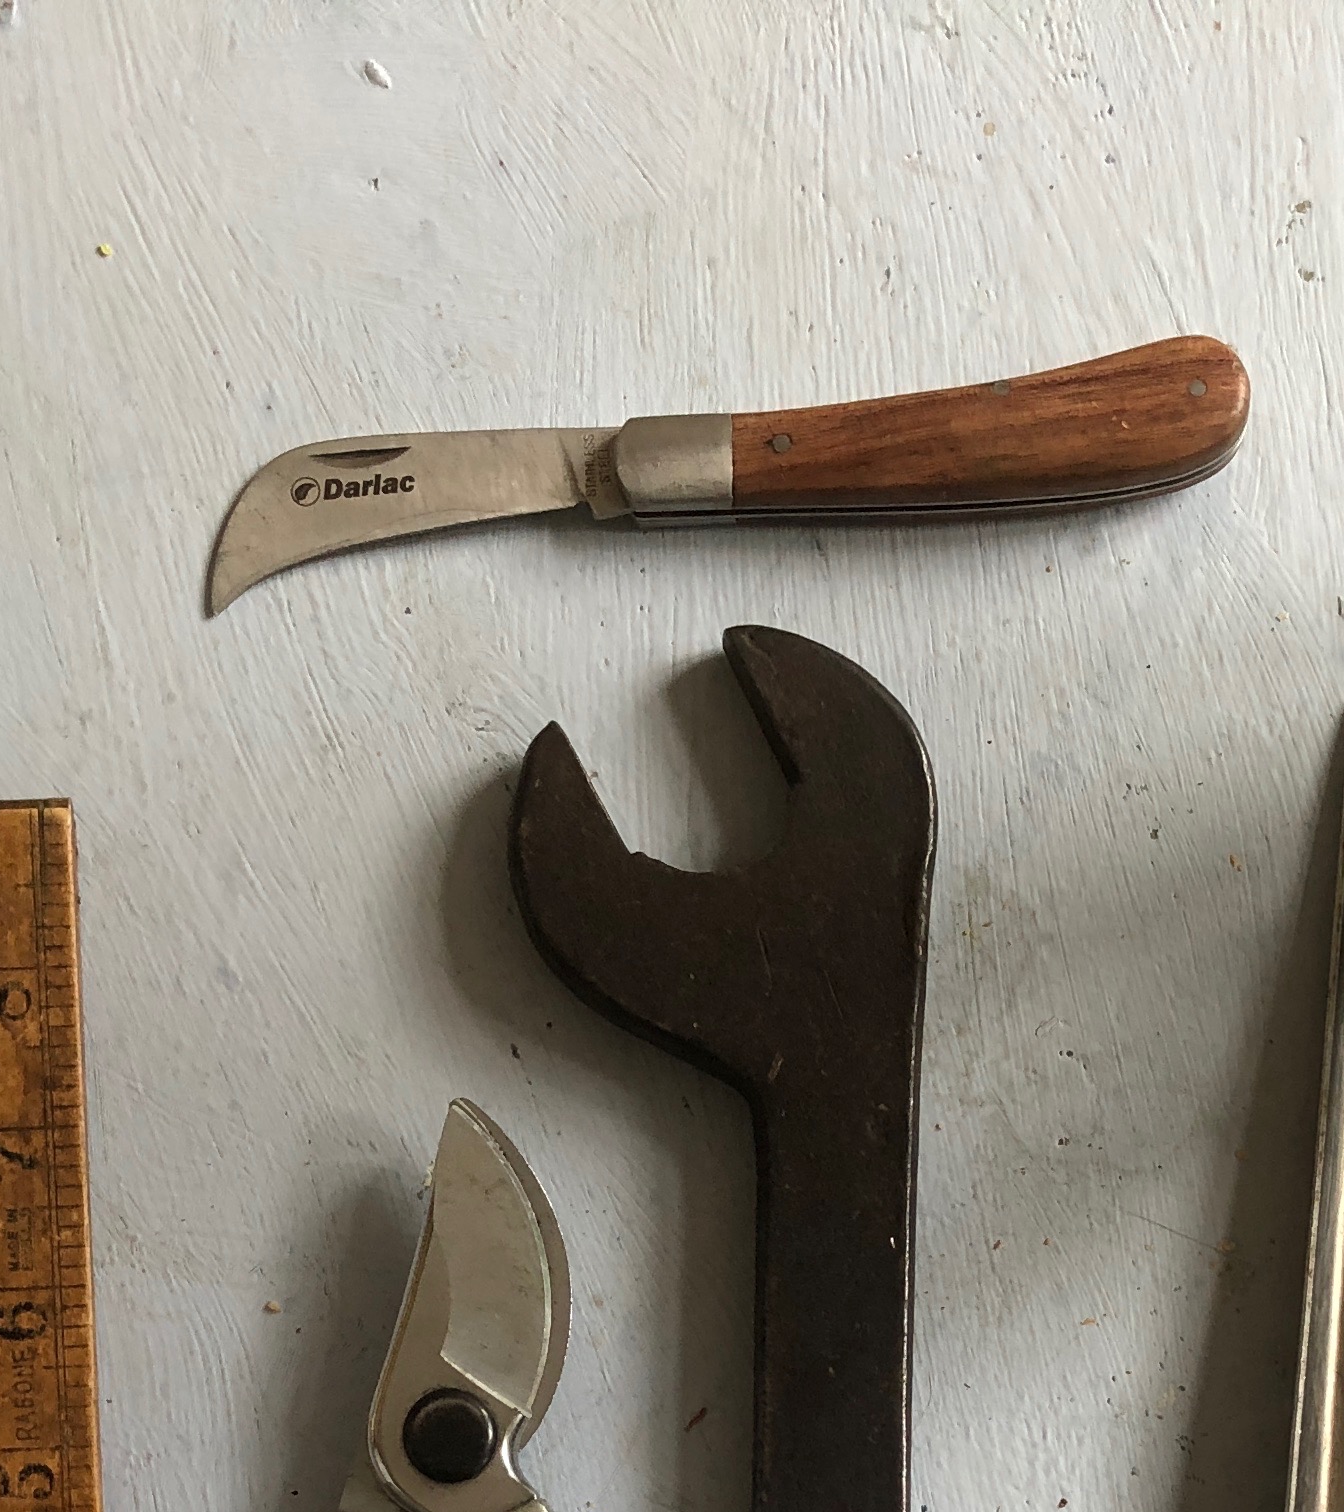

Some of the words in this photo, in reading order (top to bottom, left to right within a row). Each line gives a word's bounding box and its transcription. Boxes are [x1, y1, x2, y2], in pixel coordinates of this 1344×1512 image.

[323, 474, 416, 501] Darlac
[583, 433, 598, 498] STAINLESS
[11, 1346, 41, 1443] RABONE
